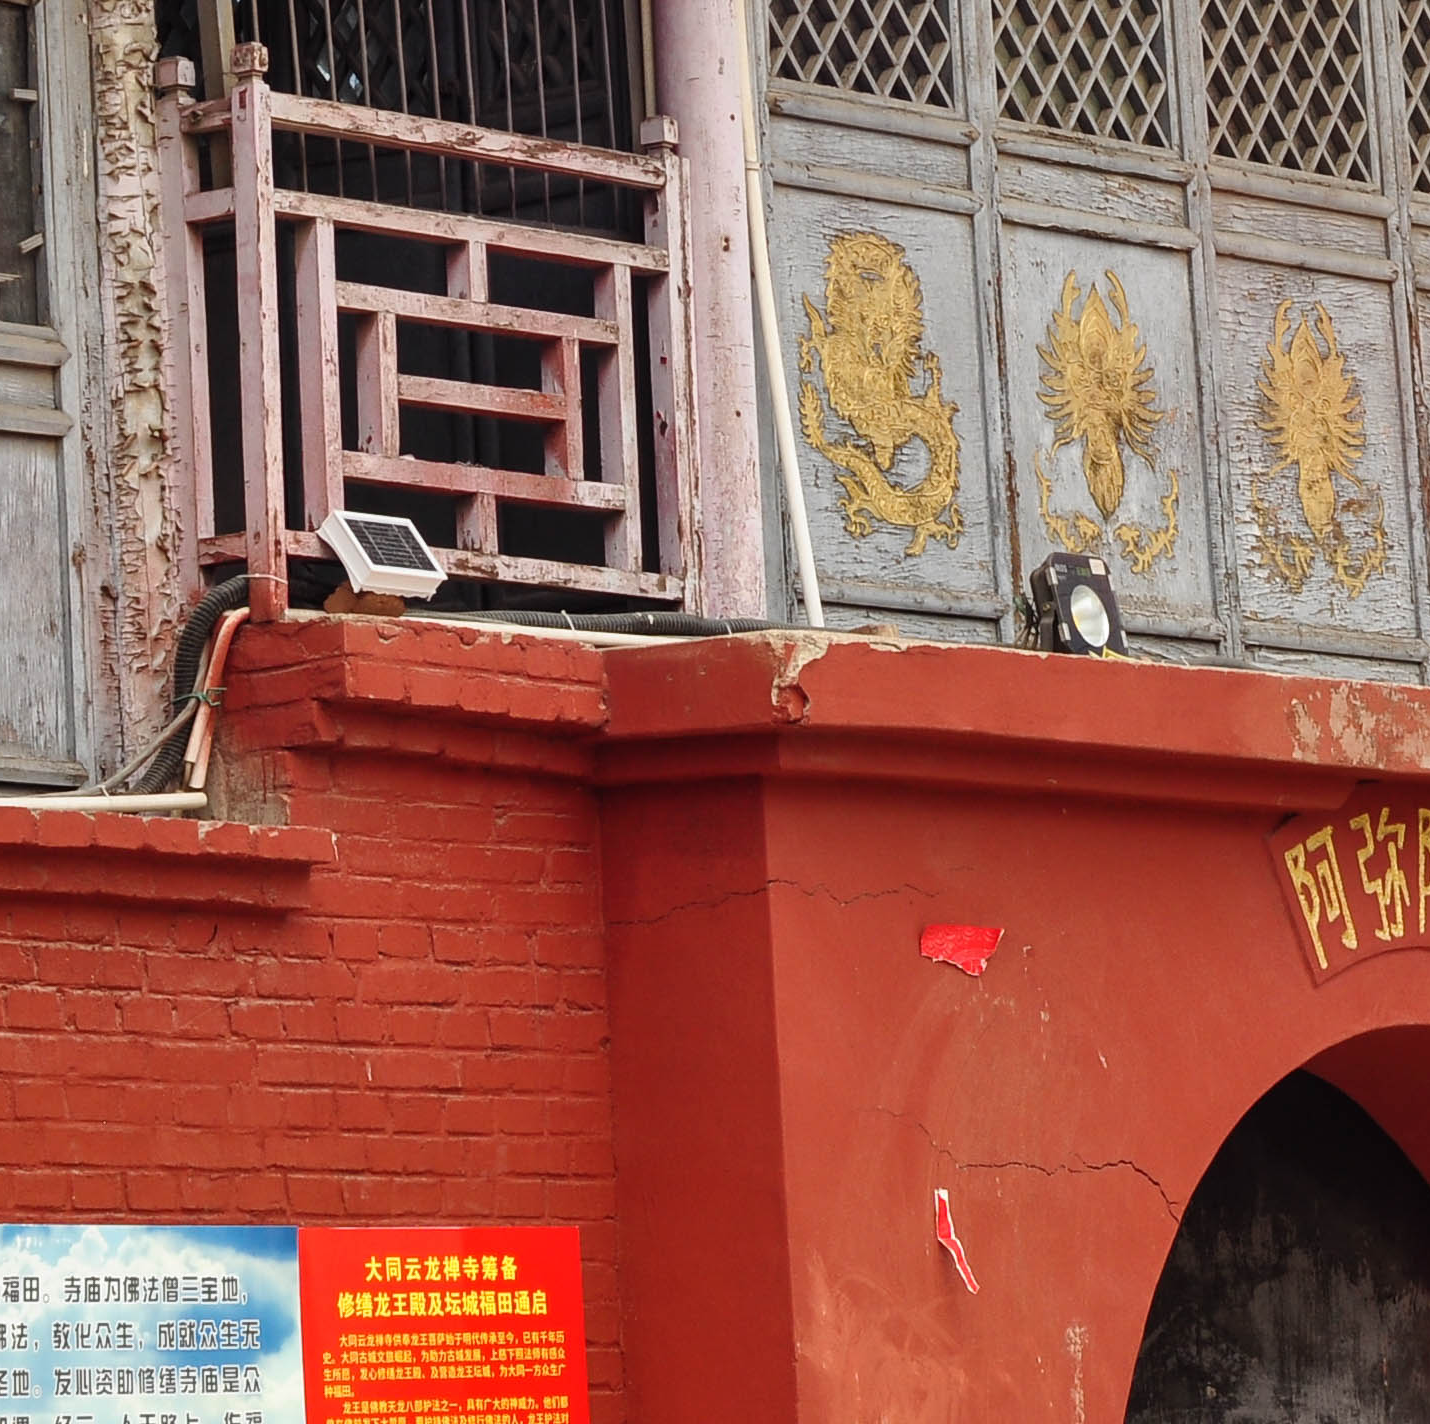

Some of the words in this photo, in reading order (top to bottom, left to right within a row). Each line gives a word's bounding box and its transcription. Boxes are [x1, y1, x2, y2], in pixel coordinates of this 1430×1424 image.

[365, 1255, 518, 1282] 大同云龙禅寺筹备
[337, 1290, 548, 1318] 修缮龙王殿及坛城福田通启
